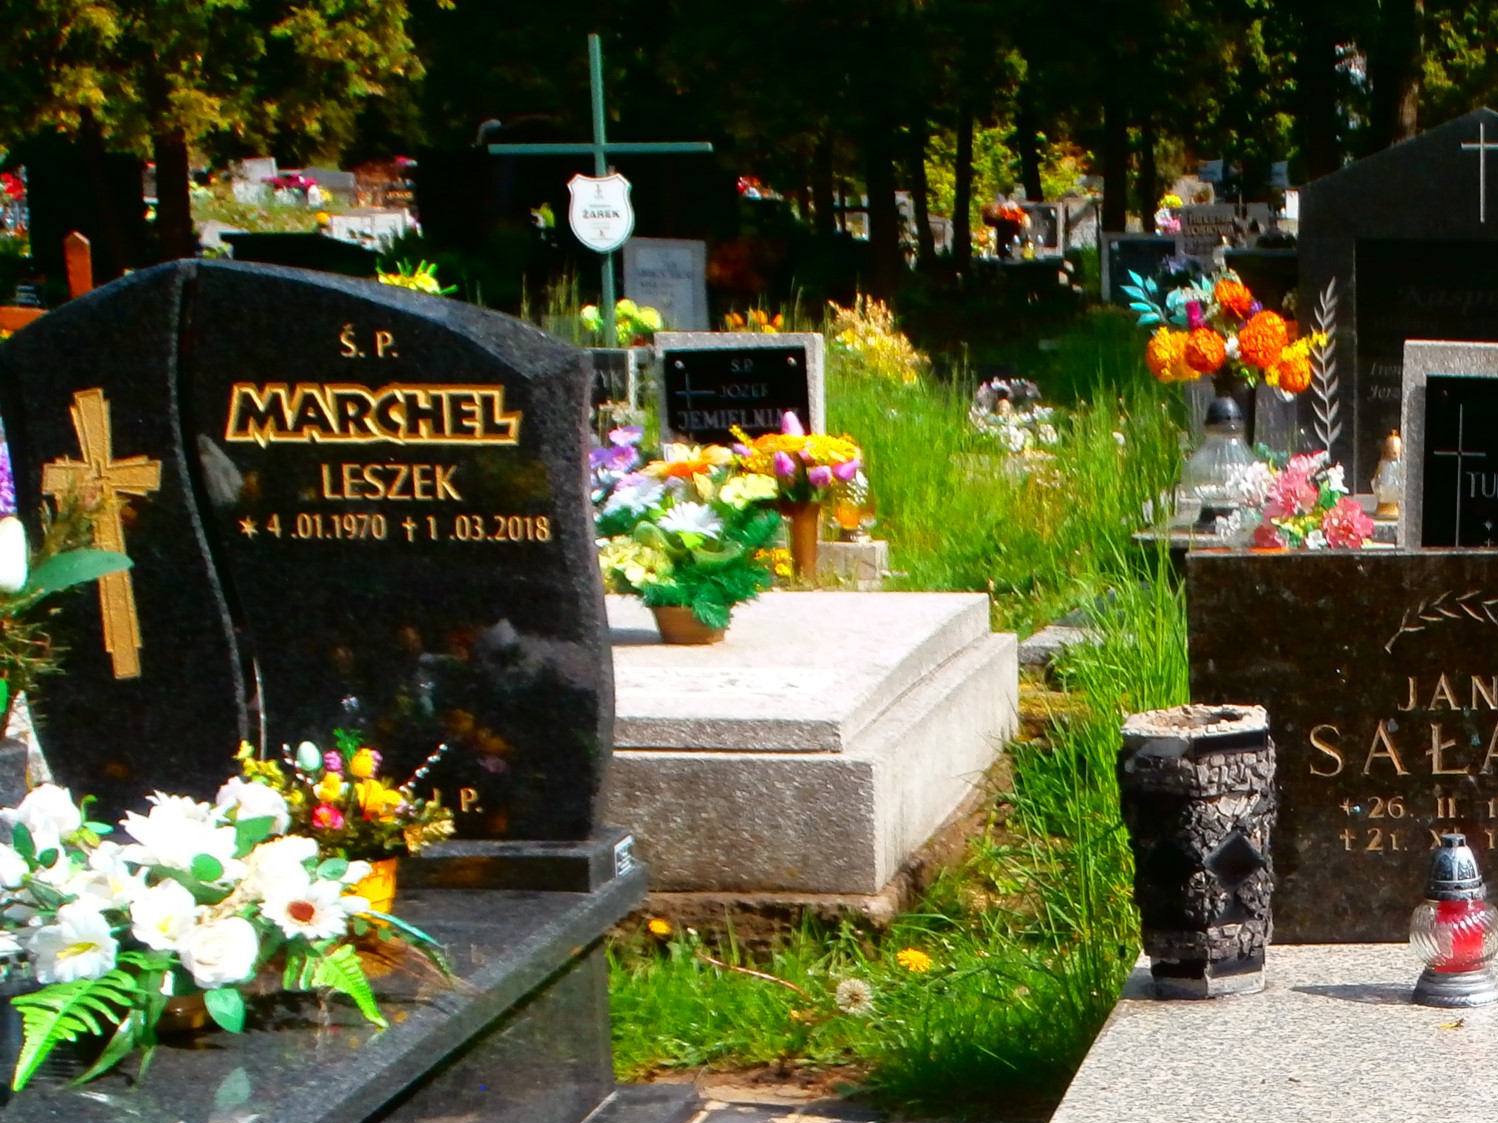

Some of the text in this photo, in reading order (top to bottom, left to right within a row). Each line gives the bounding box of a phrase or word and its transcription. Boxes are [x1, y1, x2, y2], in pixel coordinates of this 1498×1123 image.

[224, 382, 523, 448] MARCHEL
[321, 463, 462, 500] LESZEK
[1397, 671, 1498, 711] JAN
